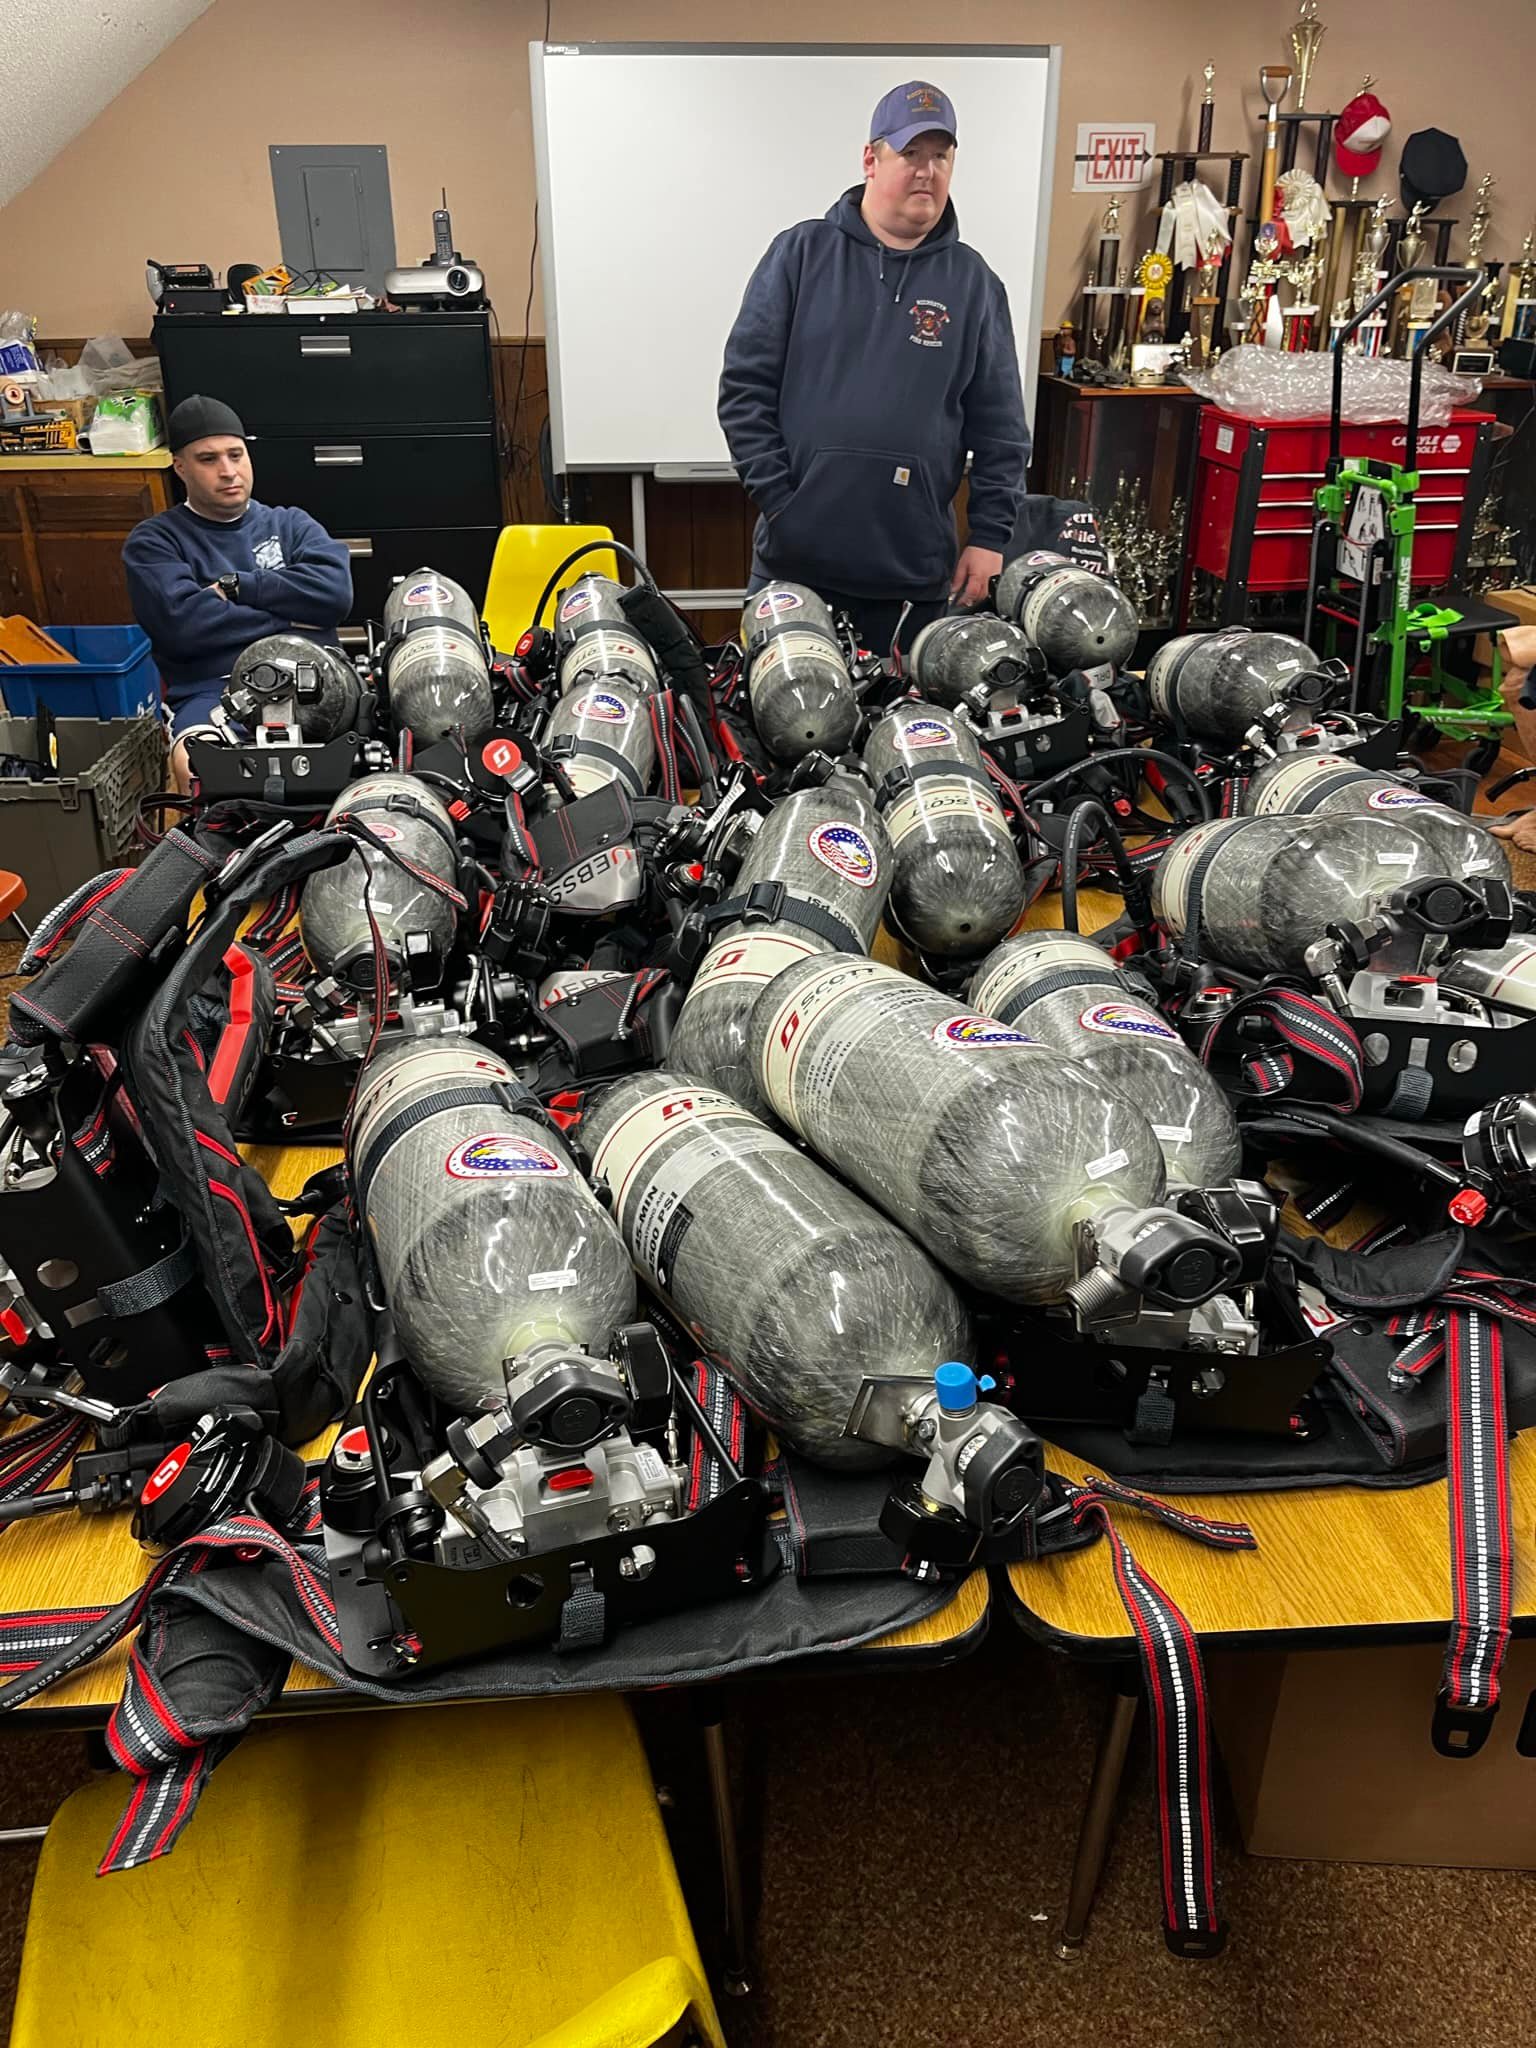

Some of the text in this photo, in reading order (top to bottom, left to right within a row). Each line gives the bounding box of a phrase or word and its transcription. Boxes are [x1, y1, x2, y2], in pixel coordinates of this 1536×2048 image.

[1092, 138, 1140, 180] EXIT
[1397, 556, 1412, 611] stryker
[801, 967, 877, 1012] SCOTT
[636, 1185, 658, 1251] 45-MIN
[658, 1190, 679, 1224] PSI
[80, 1644, 95, 1657] PSI
